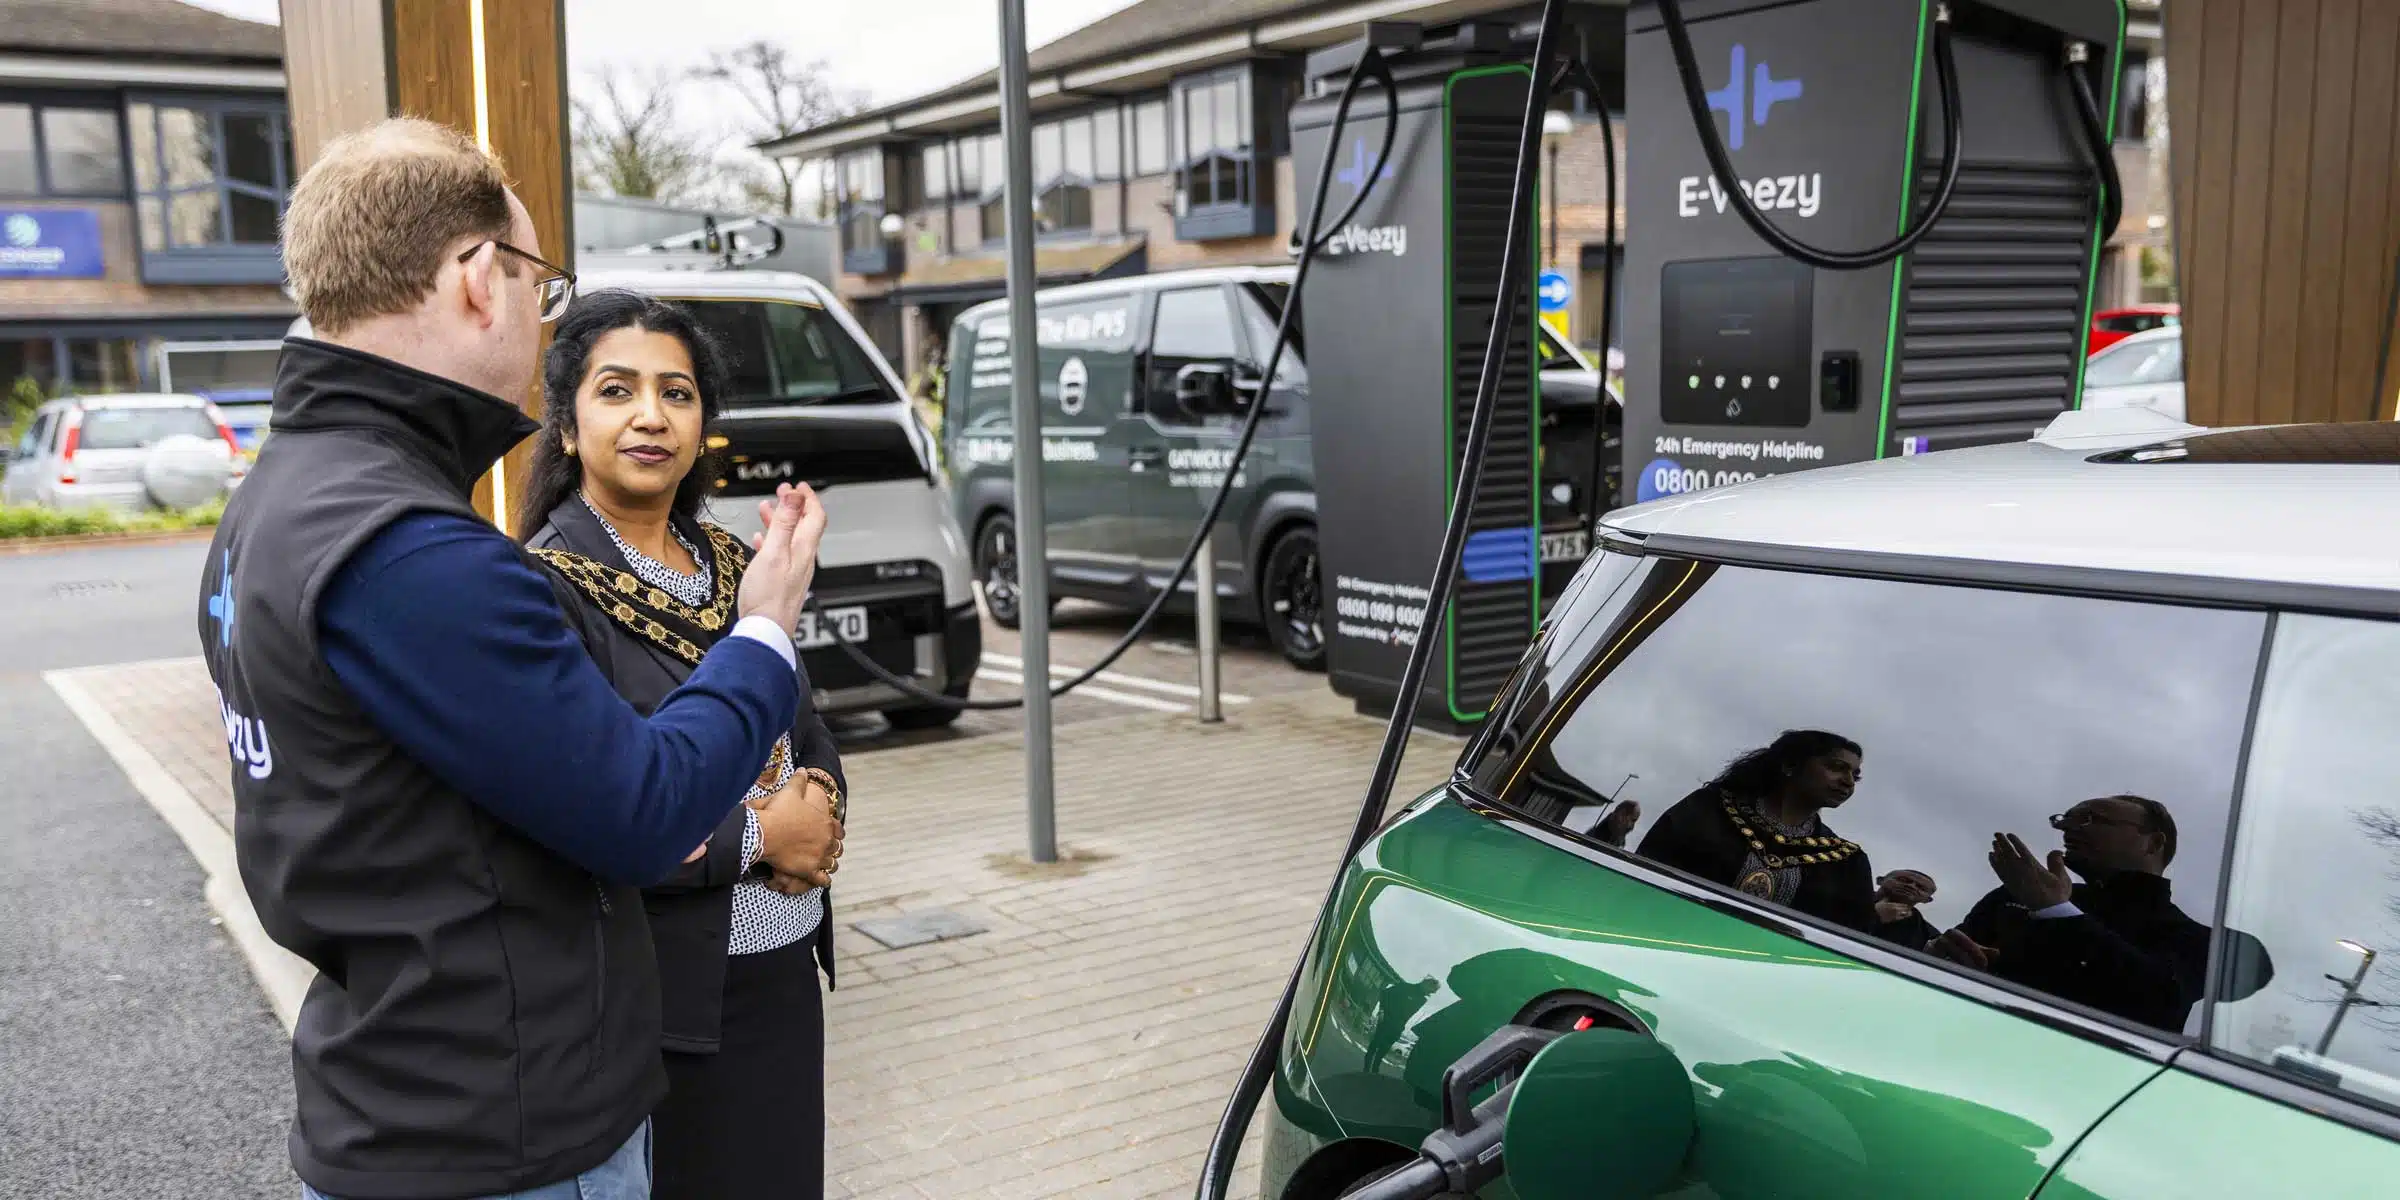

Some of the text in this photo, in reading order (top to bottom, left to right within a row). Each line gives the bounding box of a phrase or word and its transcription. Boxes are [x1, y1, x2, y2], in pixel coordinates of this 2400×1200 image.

[1655, 436, 1824, 462] 24h Emergency Helpline
[1655, 467, 1709, 493] 0800
[1351, 577, 1395, 598] Emergency
[1337, 597, 1369, 619] 0800
